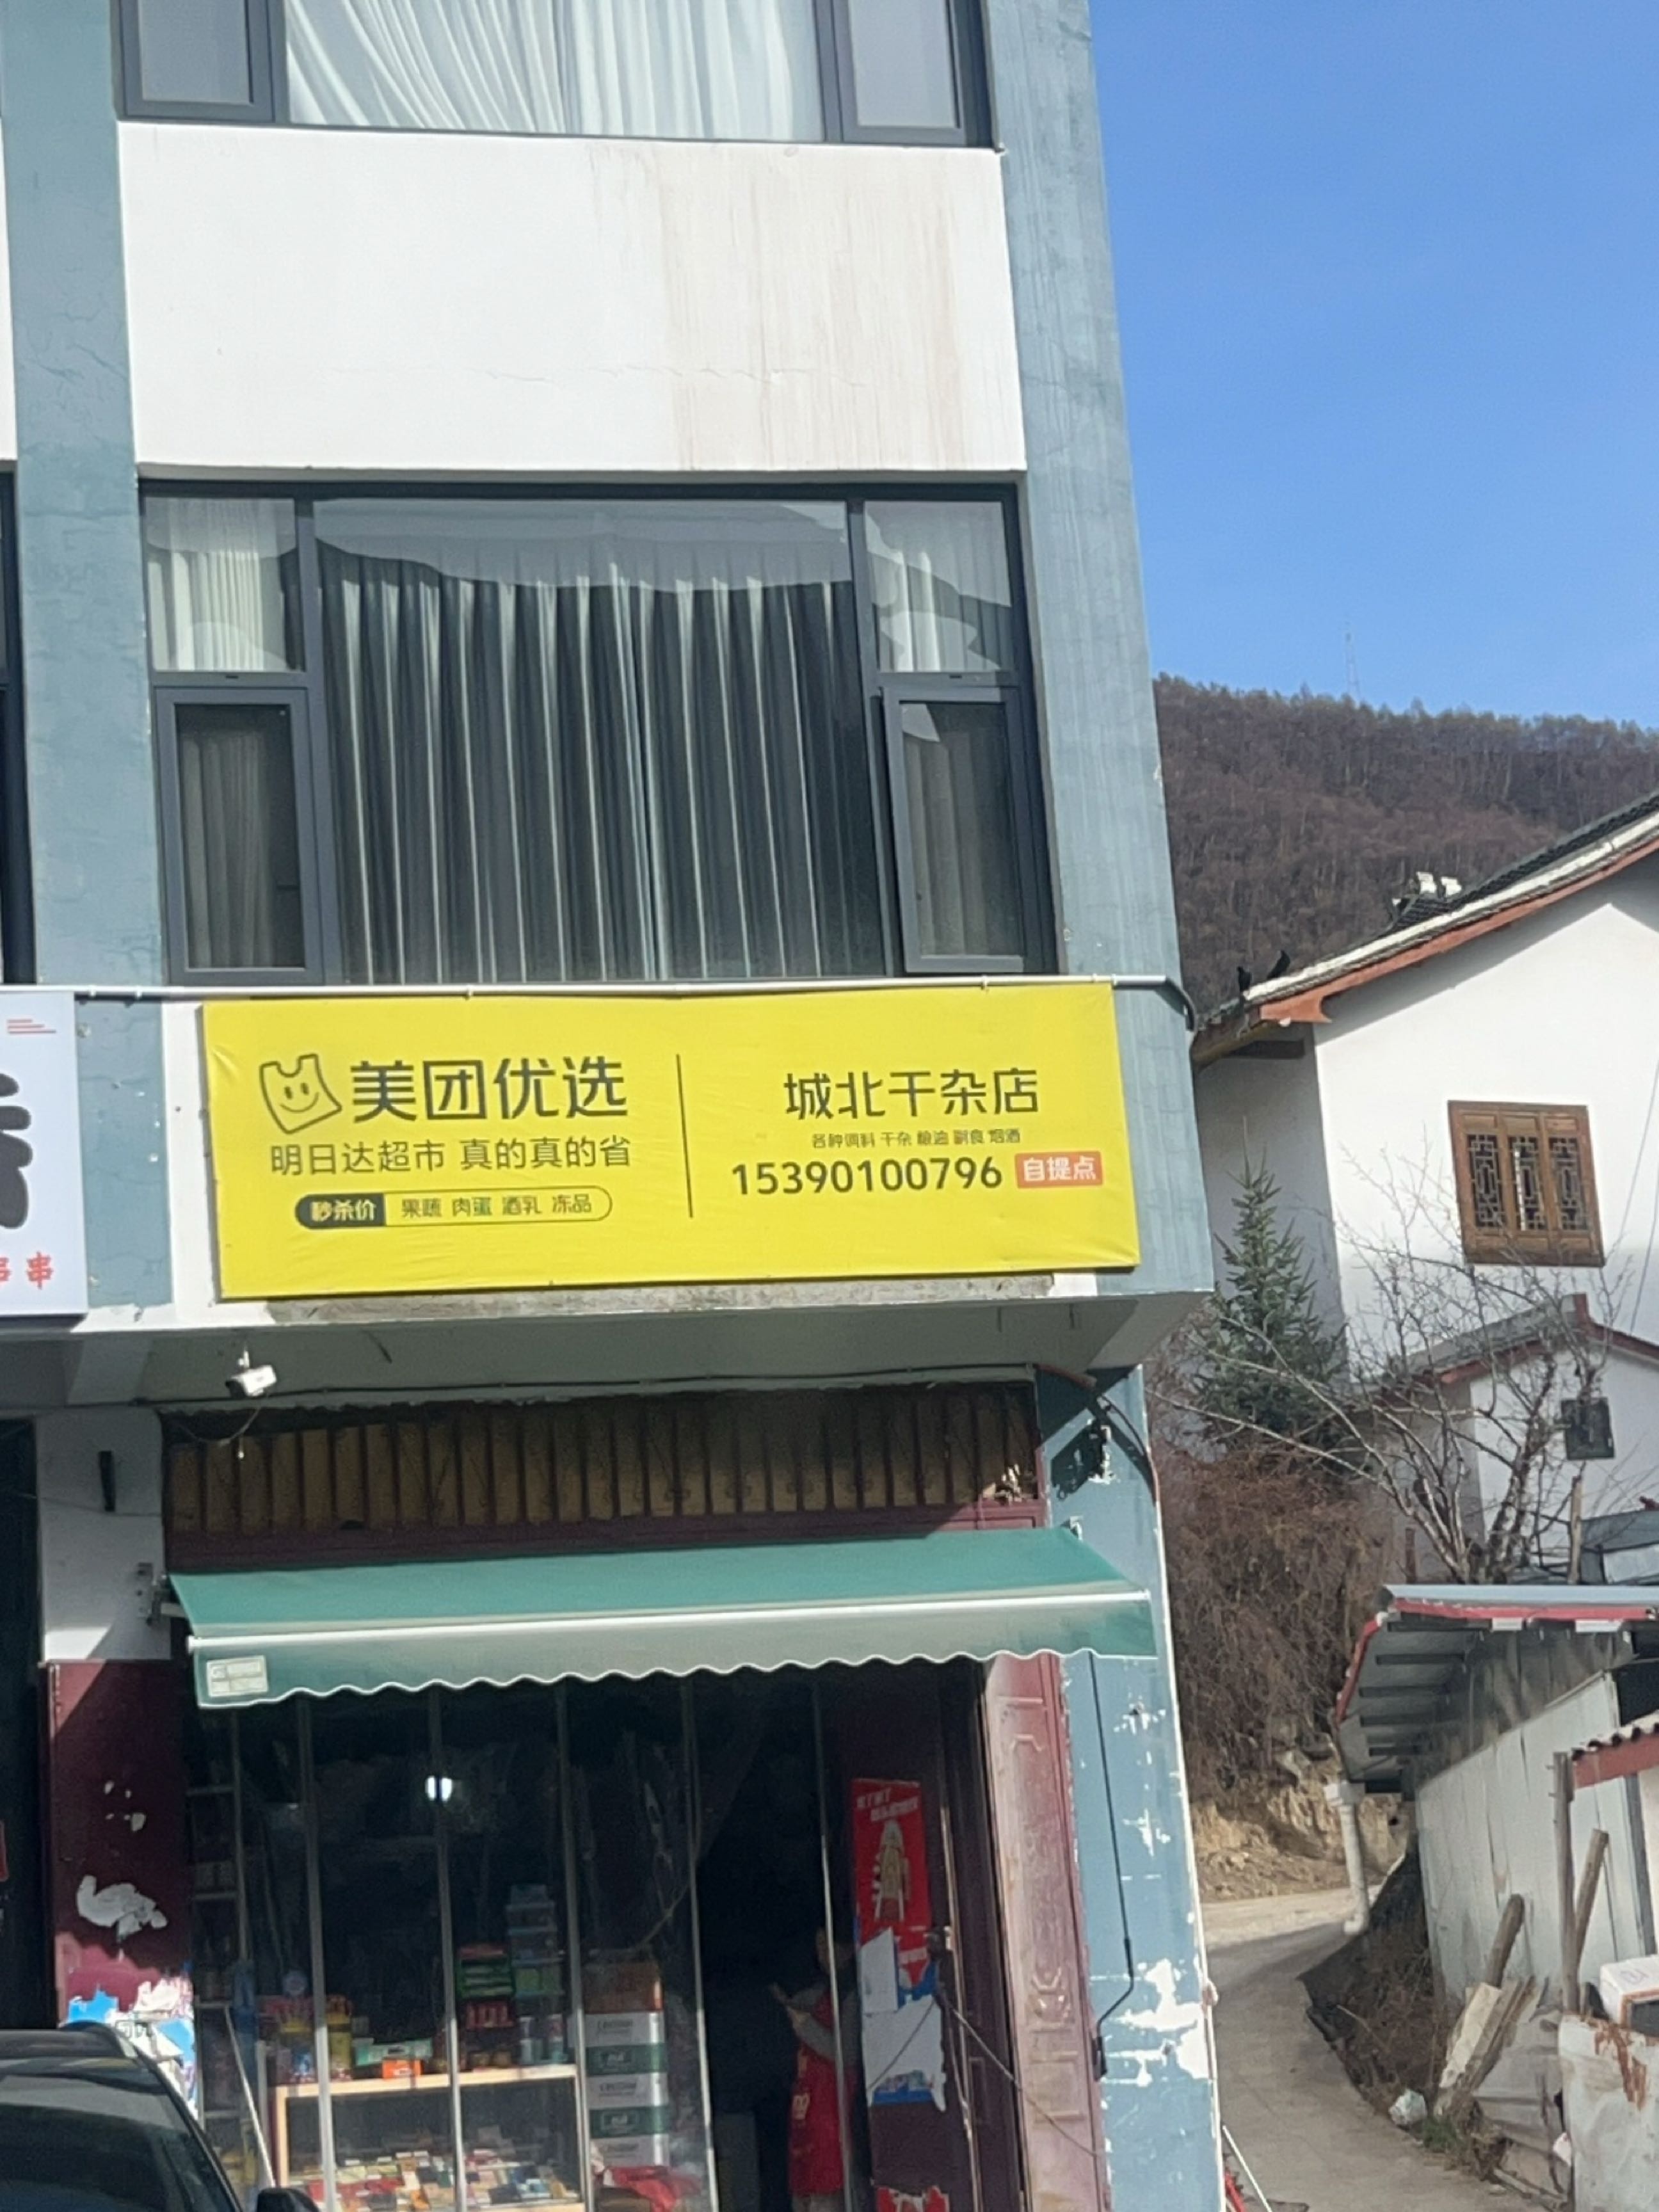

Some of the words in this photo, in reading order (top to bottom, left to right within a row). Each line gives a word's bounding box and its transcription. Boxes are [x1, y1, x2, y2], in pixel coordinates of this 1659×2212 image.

[350, 1056, 628, 1123] 美团优选
[783, 1067, 1039, 1120] 城北干杂店
[270, 1139, 445, 1176] 明日达超市
[460, 1135, 631, 1171] 真的真的省
[812, 1132, 875, 1149] 各种调料
[880, 1131, 911, 1148] 干杂
[732, 1156, 1003, 1196] 15390100796
[1022, 1155, 1097, 1182] 自提点
[310, 1198, 378, 1222] 秒杀价
[401, 1198, 442, 1219] 果蔬
[451, 1196, 492, 1217] 肉蛋
[501, 1194, 542, 1215] 酒乳
[552, 1194, 593, 1214] 冻品
